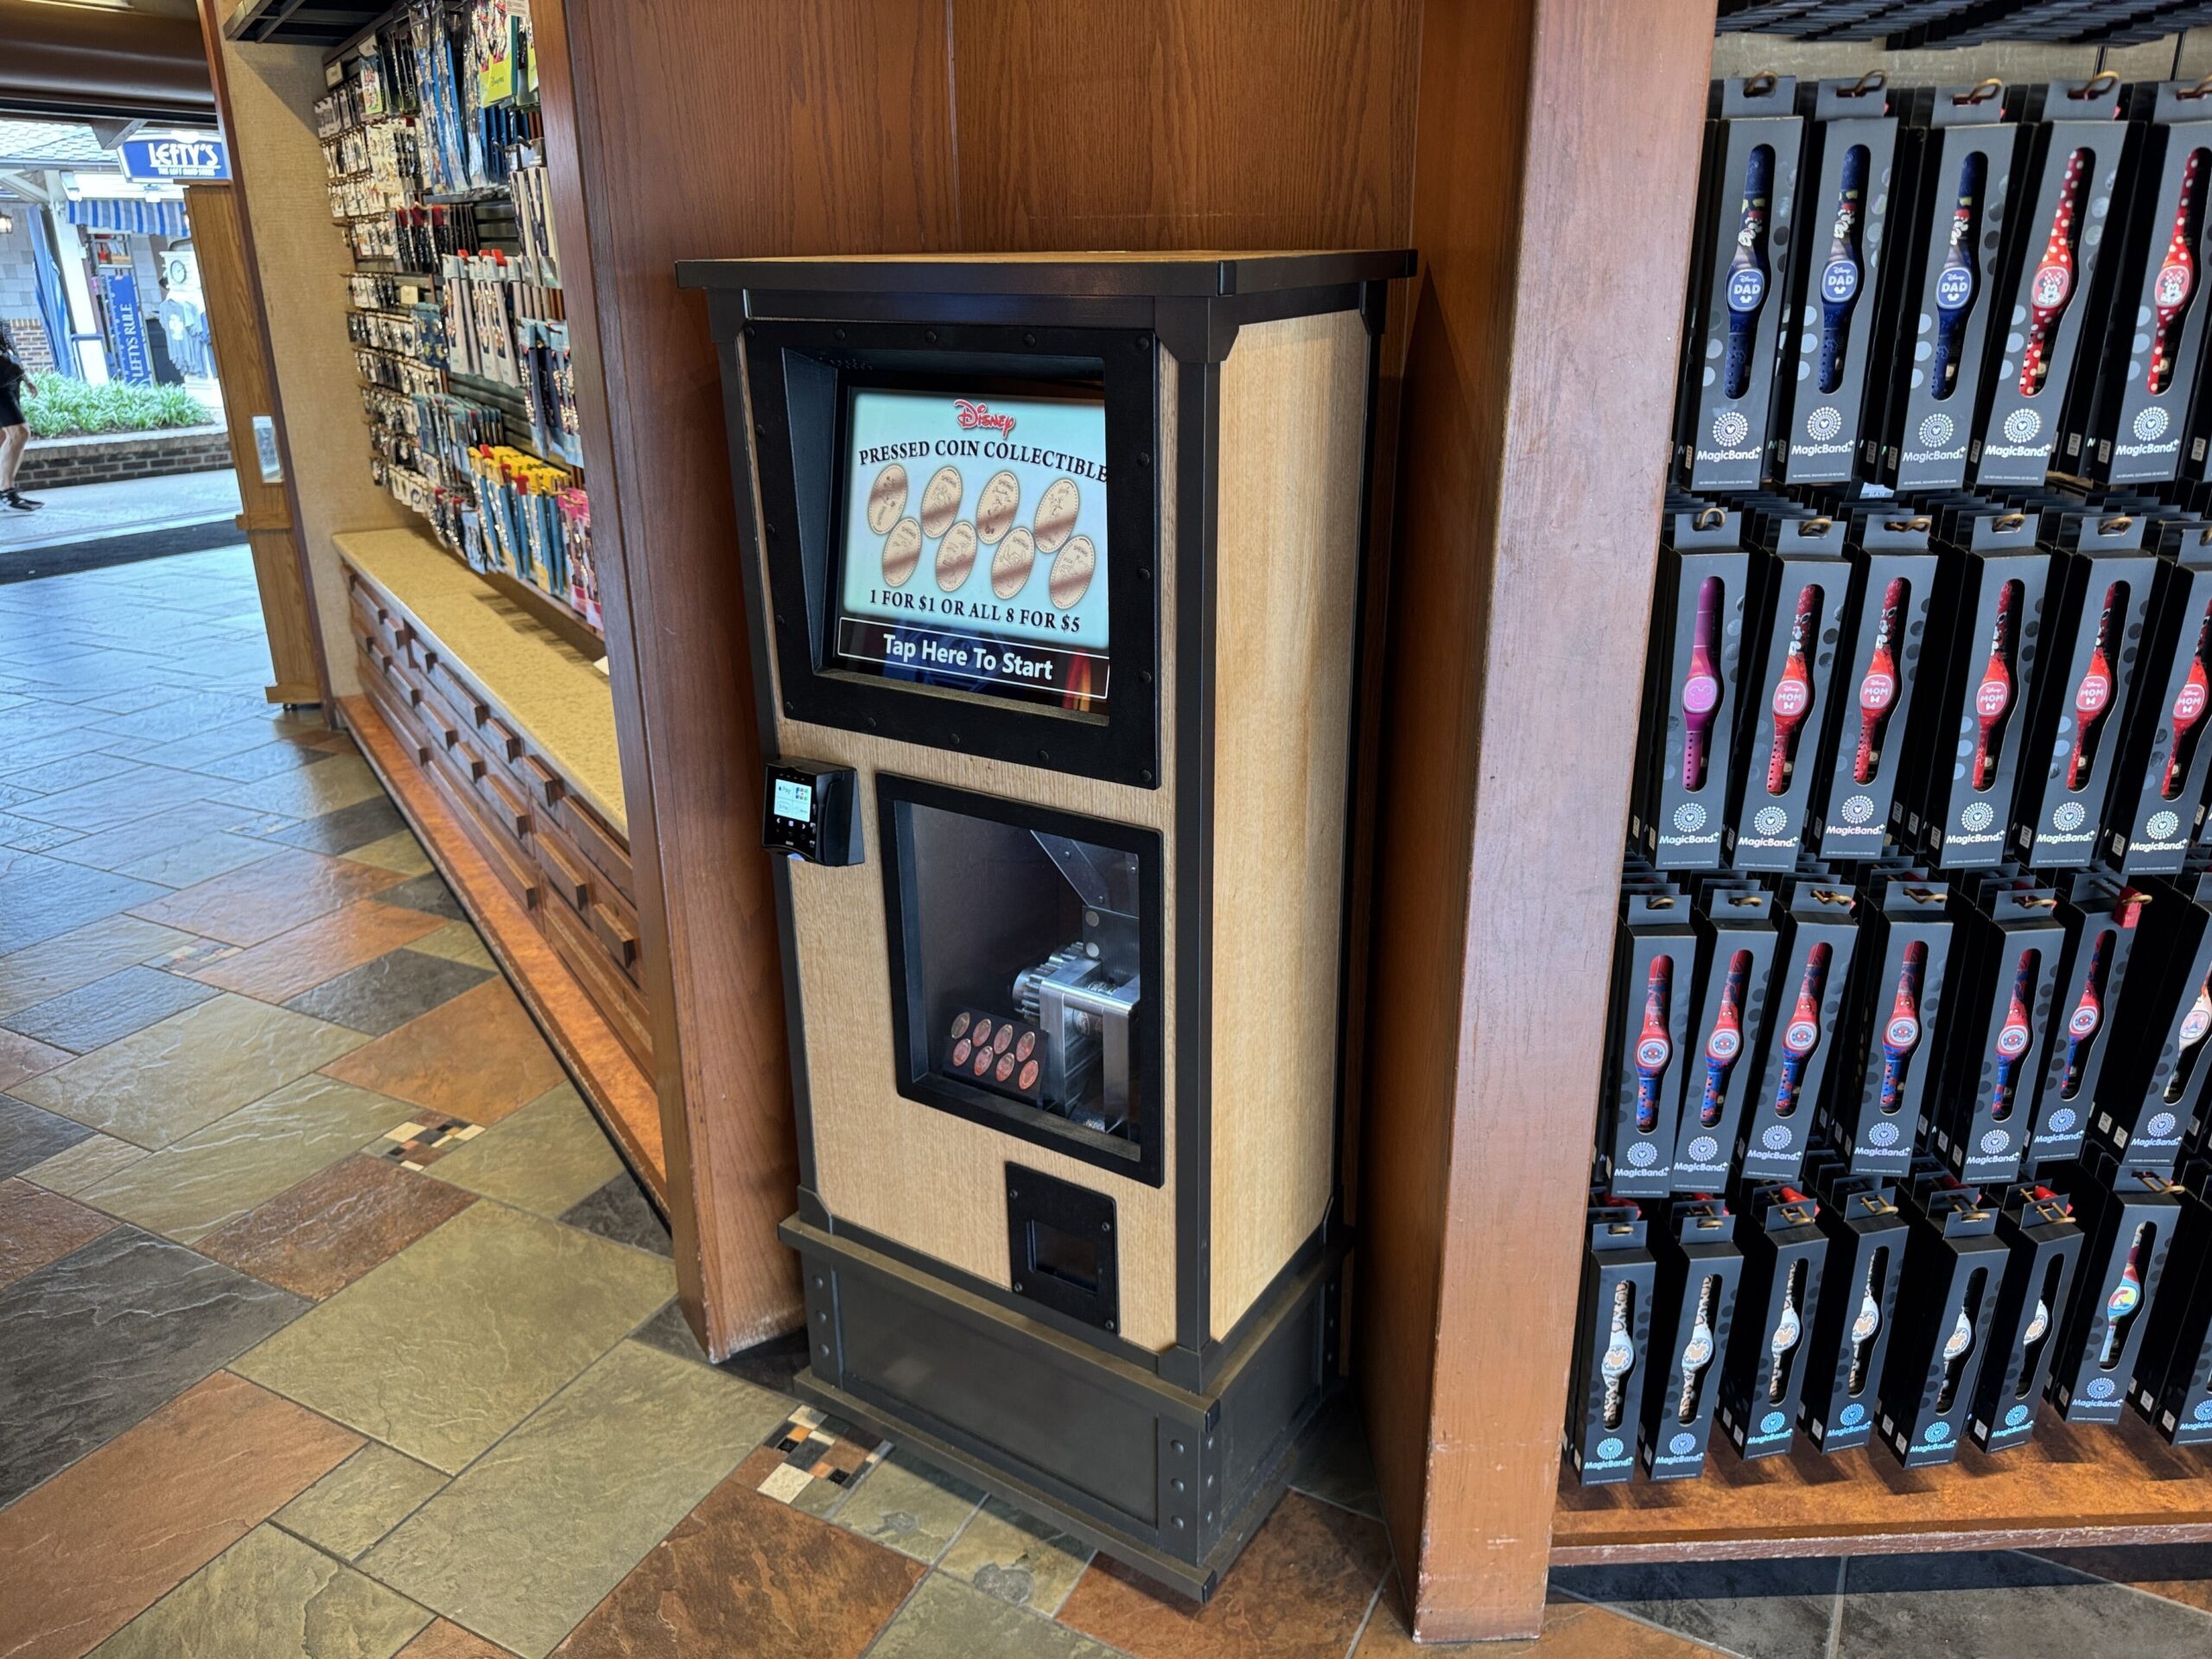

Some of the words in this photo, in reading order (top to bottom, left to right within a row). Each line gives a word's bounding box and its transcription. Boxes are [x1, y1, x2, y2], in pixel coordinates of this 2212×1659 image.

[1734, 284, 1761, 295] DAD
[1828, 276, 1854, 286] DAD
[1942, 282, 1968, 292] DAD
[119, 302, 137, 335] RULE
[954, 399, 1016, 440] Disney
[859, 440, 930, 466] PRESSED
[935, 440, 980, 457] COIN
[870, 589, 876, 603] 1
[882, 591, 914, 609] FOR
[918, 595, 935, 612] $1
[941, 598, 964, 616] OR
[968, 602, 1001, 621] ALL
[1006, 607, 1014, 622] 8
[1020, 609, 1056, 629] FOR
[1060, 614, 1080, 632] $5
[883, 633, 916, 663] Tap
[921, 639, 968, 666] Here
[973, 647, 996, 671] To
[1002, 652, 1053, 680] Start
